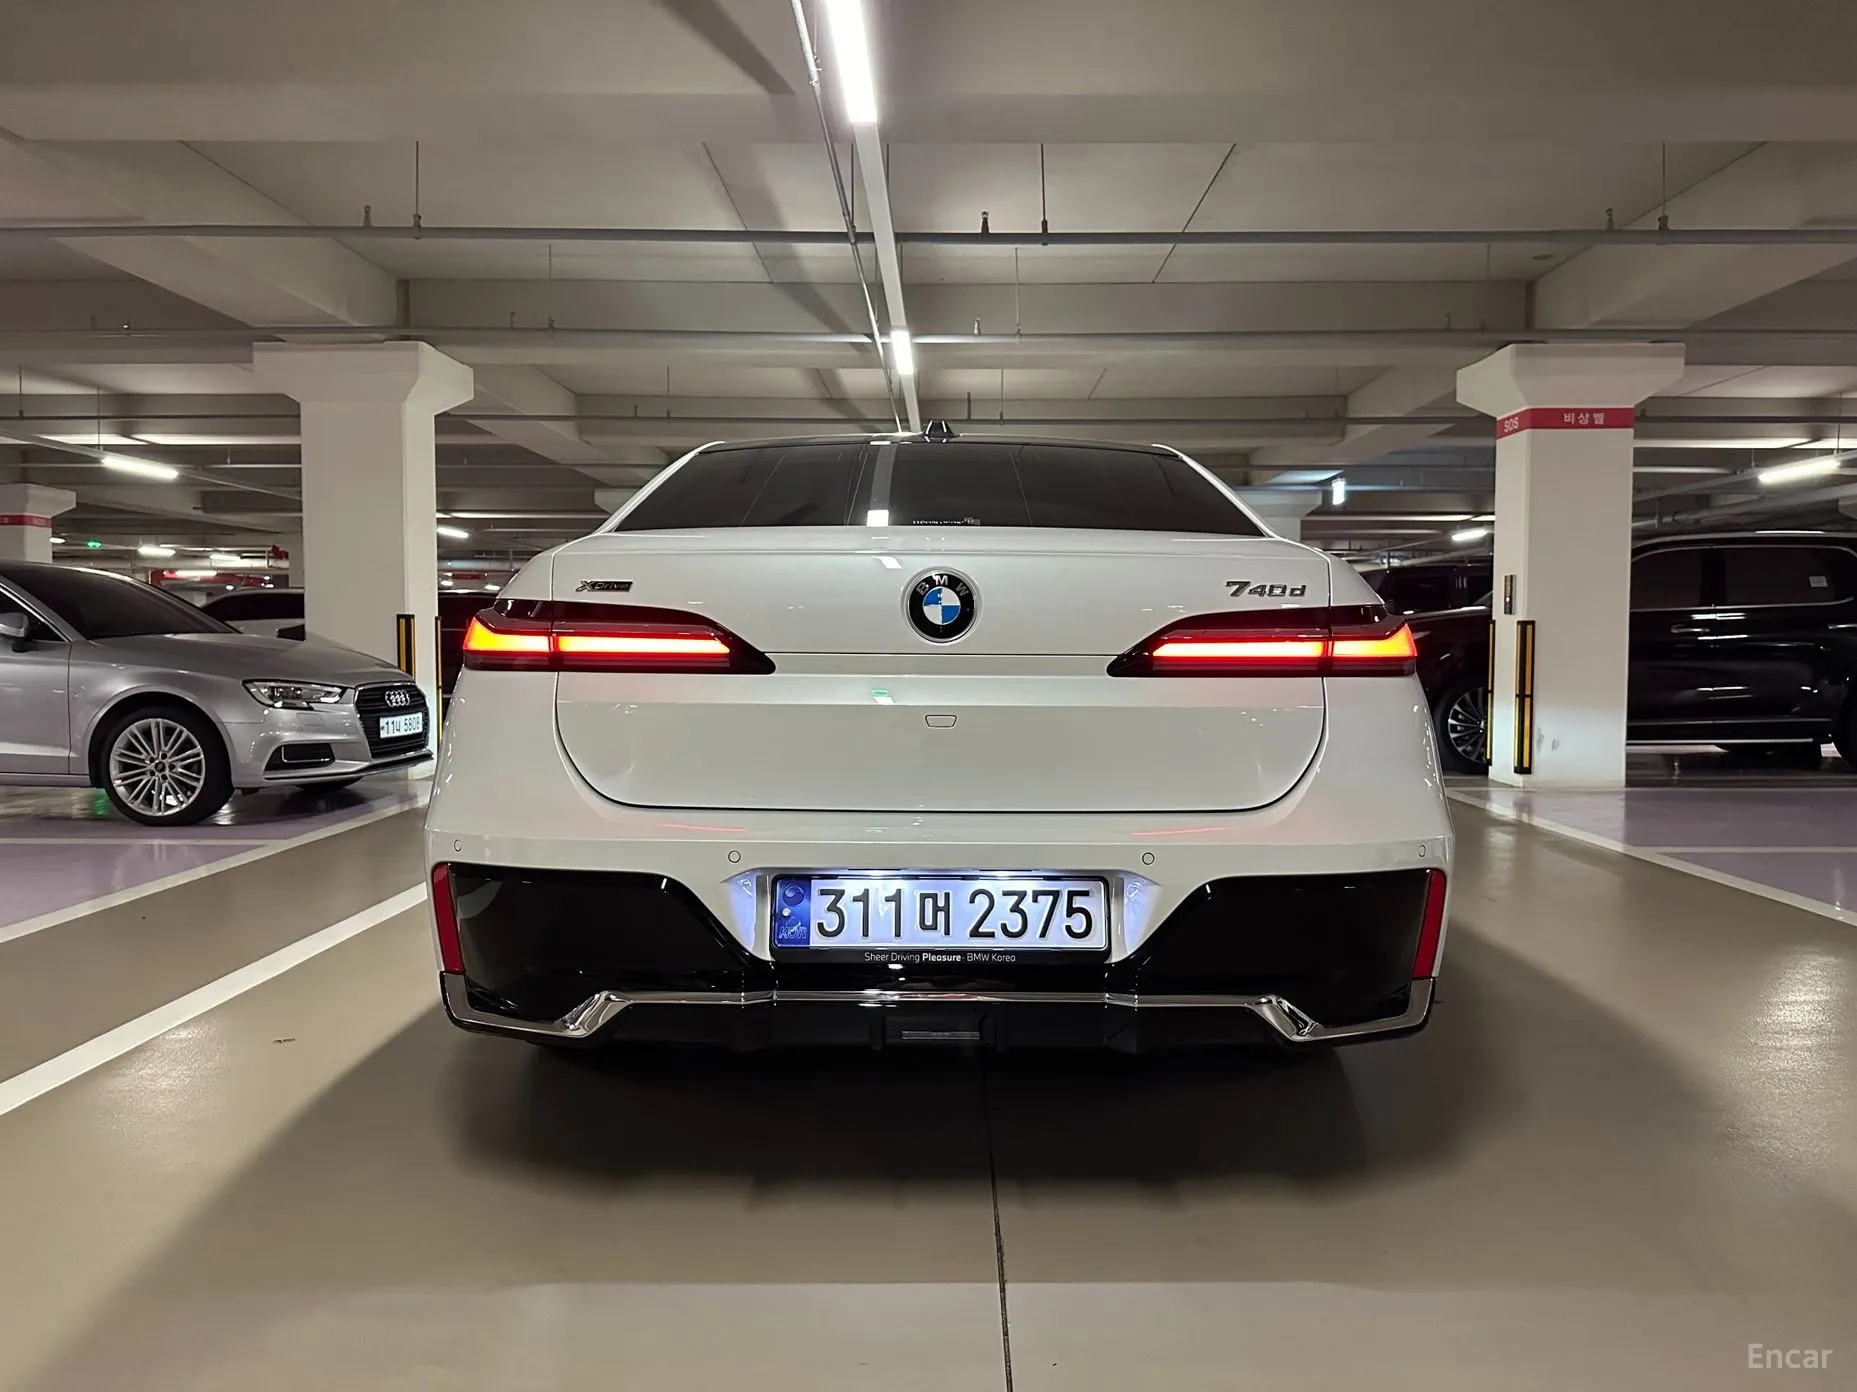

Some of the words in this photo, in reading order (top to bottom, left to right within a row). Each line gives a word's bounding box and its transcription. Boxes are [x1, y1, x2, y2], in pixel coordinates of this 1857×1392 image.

[1503, 417, 1520, 433] SOS
[1563, 413, 1605, 425] 비상벨
[915, 574, 970, 597] BMW
[1225, 580, 1307, 598] 740d
[968, 888, 1093, 939] 2375
[864, 952, 889, 962] Sheer
[890, 952, 920, 963] Driving
[966, 952, 990, 962] BMW
[991, 952, 1016, 962] Korea
